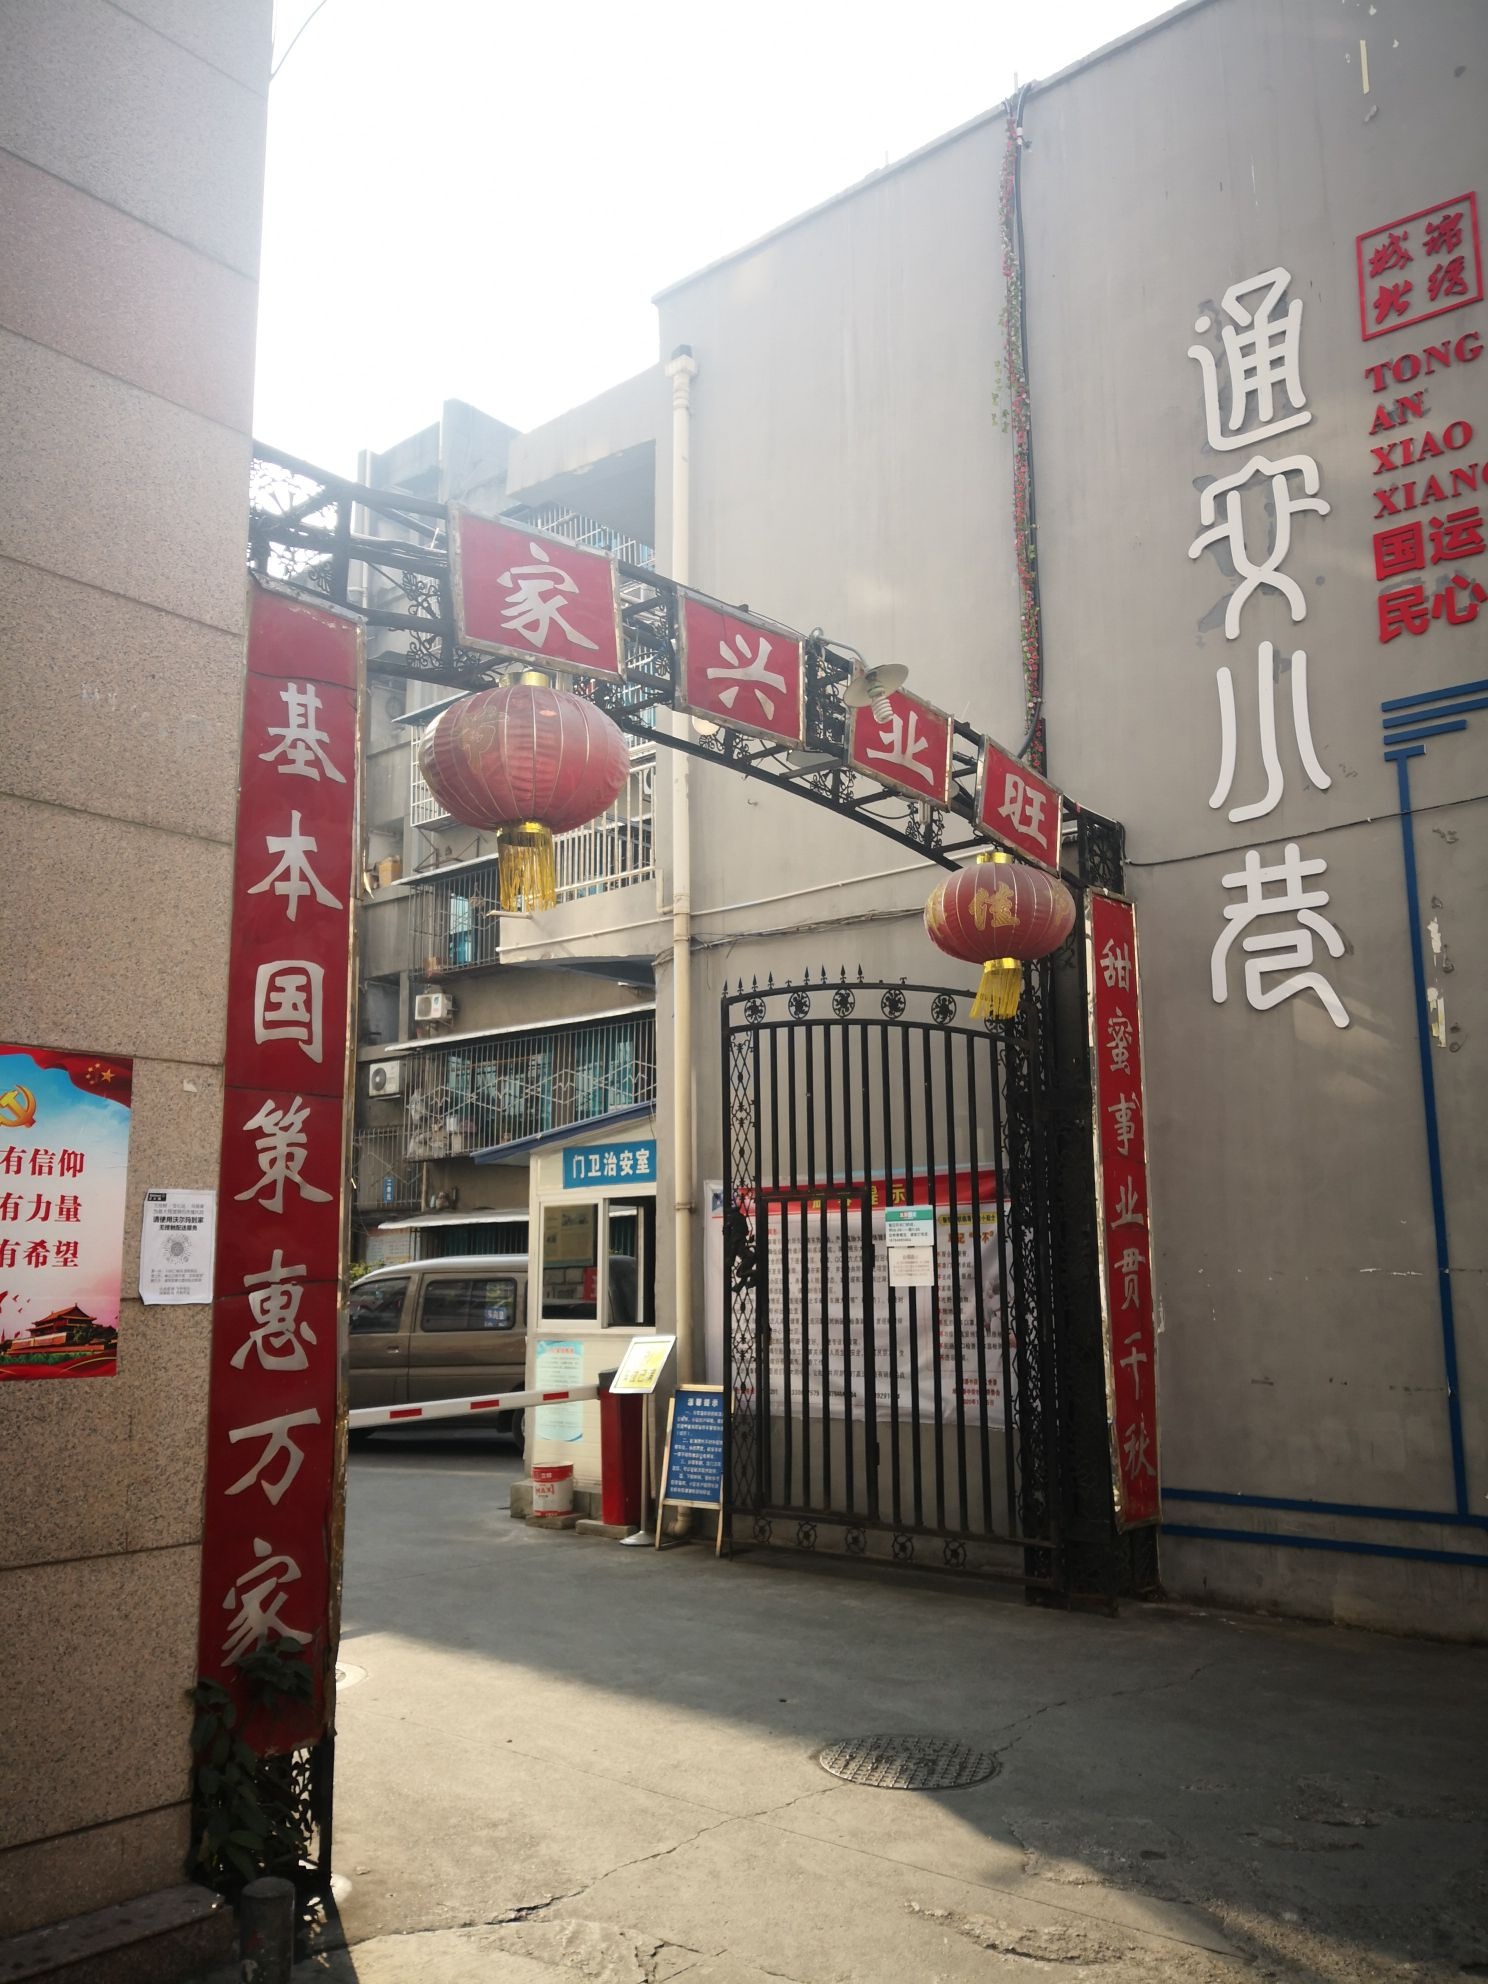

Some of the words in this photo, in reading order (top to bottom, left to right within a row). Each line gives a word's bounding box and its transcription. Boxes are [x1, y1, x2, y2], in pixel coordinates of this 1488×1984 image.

[1364, 331, 1485, 393] TONG
[1369, 389, 1424, 436] AN
[1369, 419, 1474, 476] XIAO
[1373, 461, 1488, 519] XIAN
[1373, 506, 1487, 582] 国运
[1378, 573, 1488, 644] 民心
[1187, 265, 1350, 1030] 通安小巷
[0, 1144, 86, 1178] 有信仰
[220, 681, 347, 1668] 基本国策惠万家
[572, 1147, 650, 1180] 门卫治安室
[0, 1191, 83, 1222] 有力量
[1099, 937, 1157, 1480] 甜蜜事业贯千秋
[0, 1238, 80, 1269] 有希望
